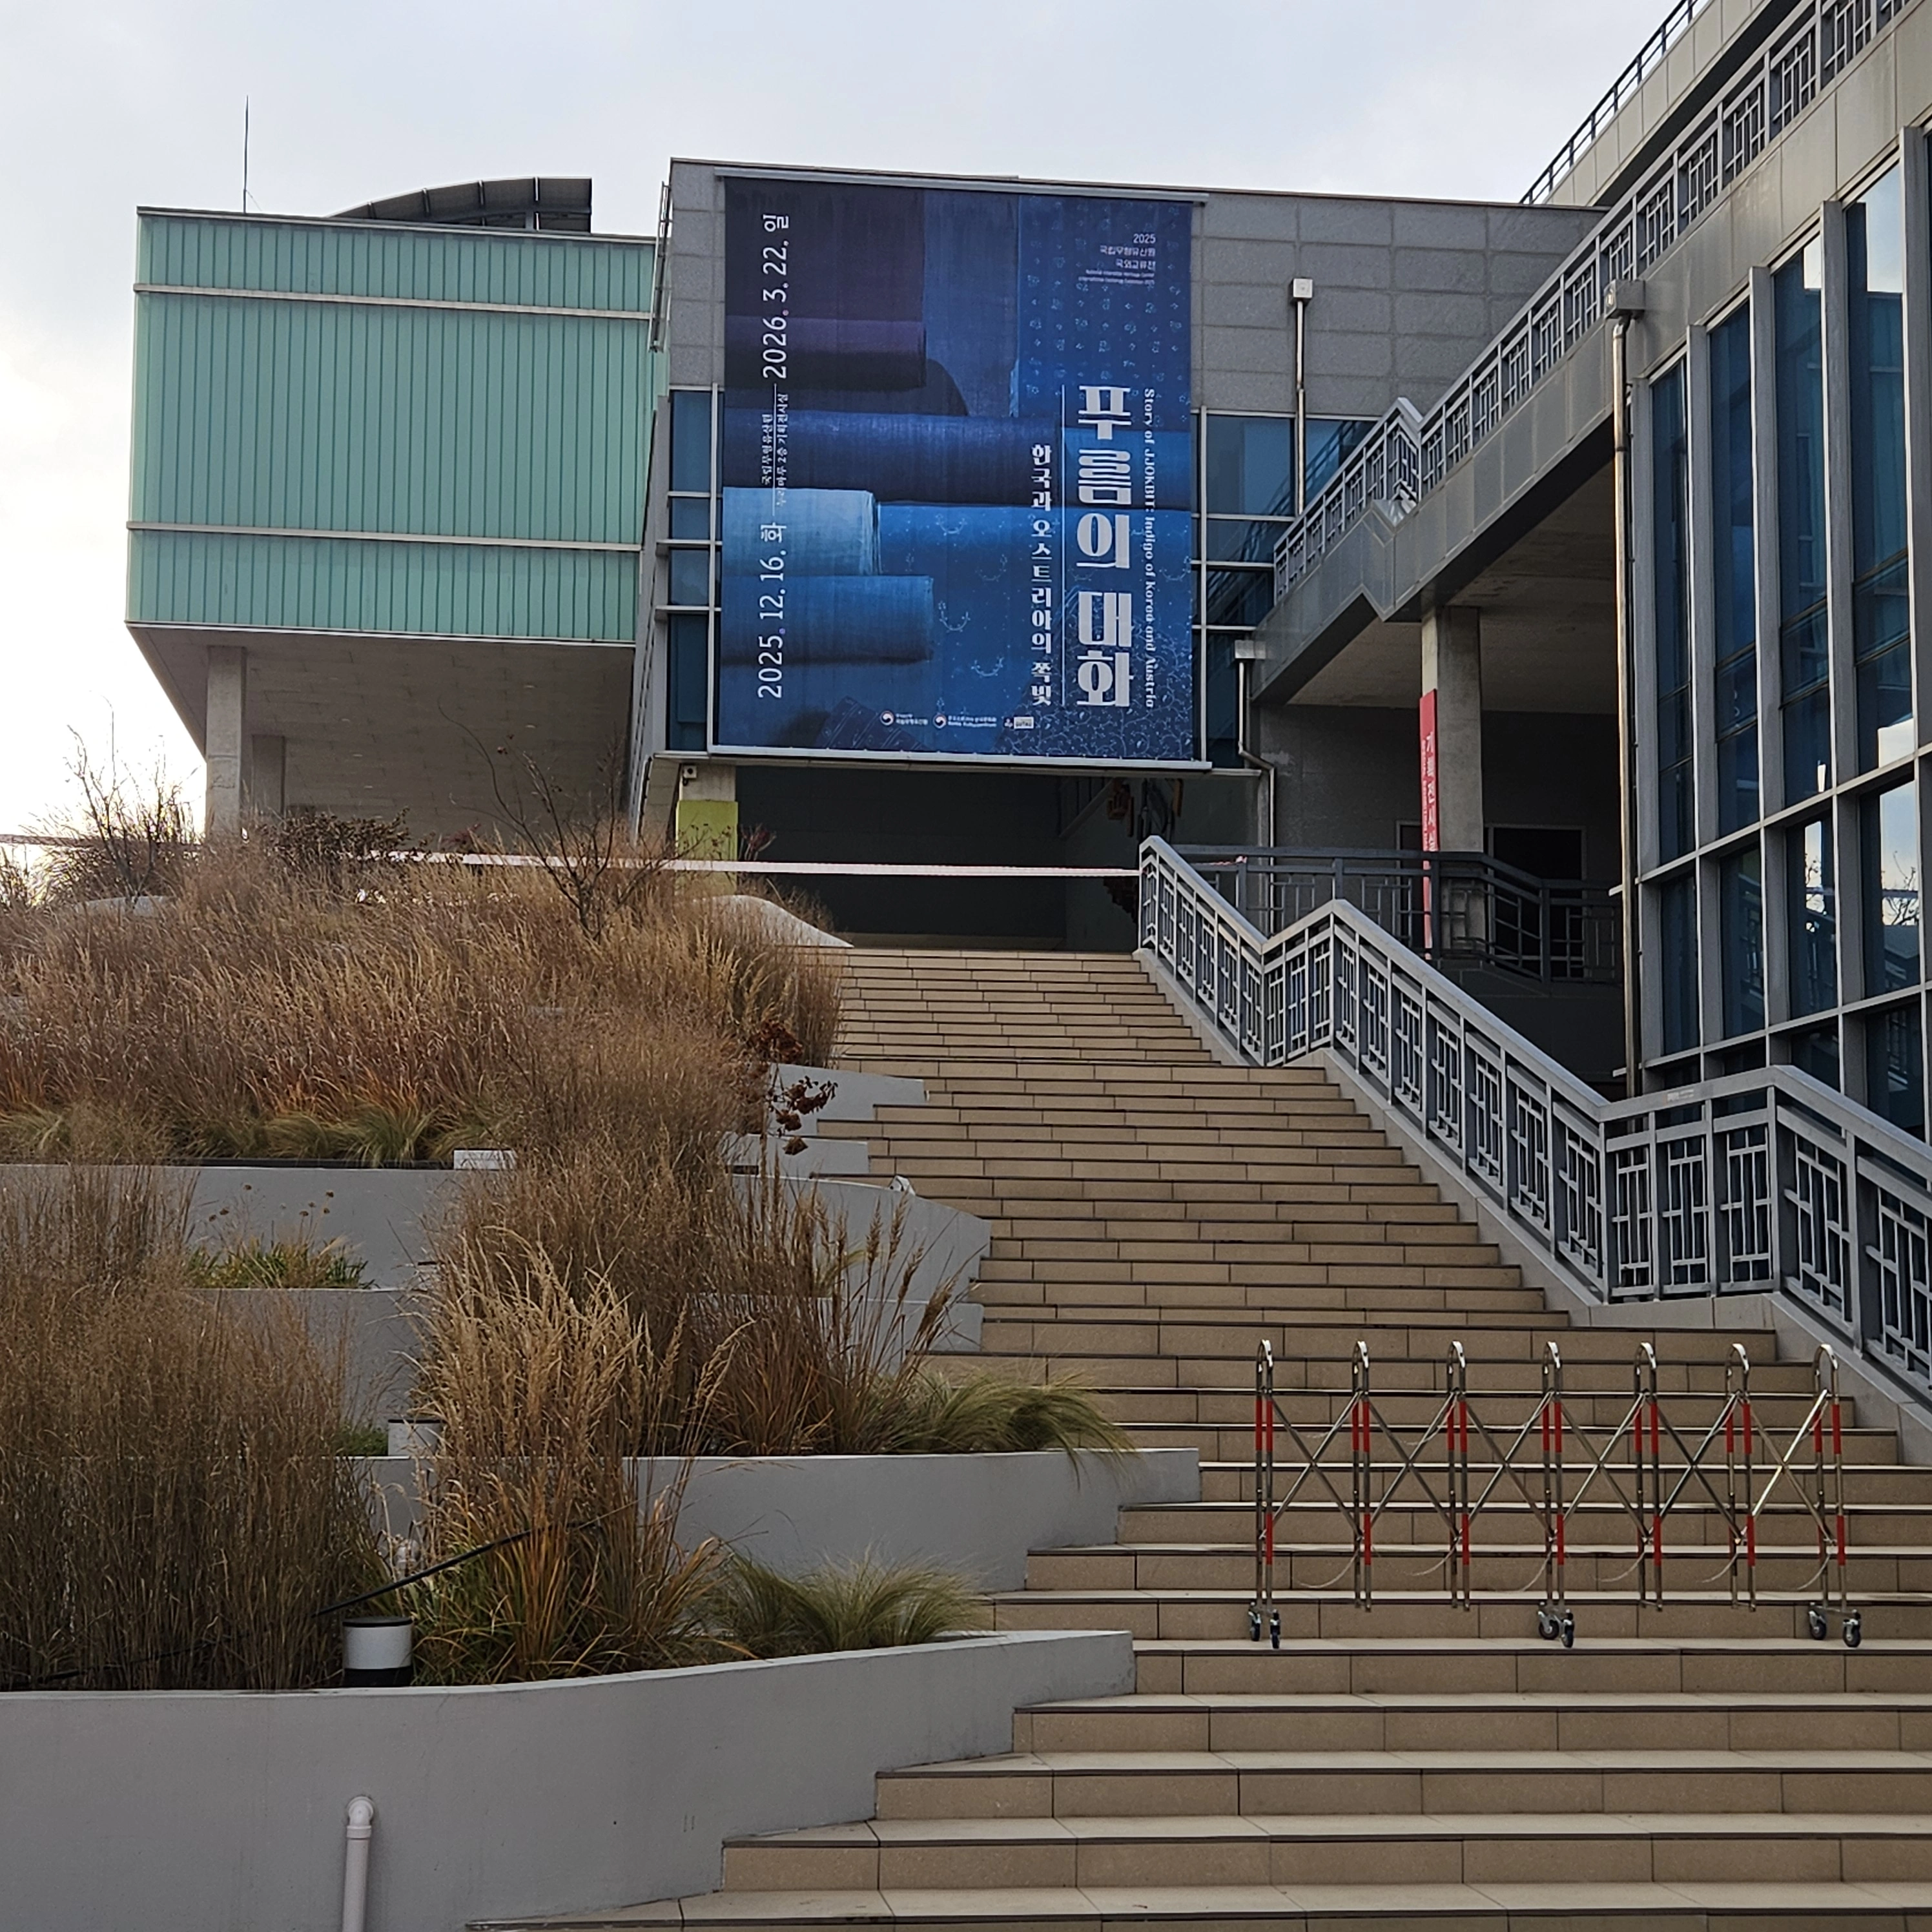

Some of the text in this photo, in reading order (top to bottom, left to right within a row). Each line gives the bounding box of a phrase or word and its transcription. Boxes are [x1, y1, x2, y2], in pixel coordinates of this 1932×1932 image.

[763, 214, 789, 379] 2026. 3. 22. 일
[1133, 233, 1156, 243] 2025
[762, 414, 773, 485] 국립무형유산원
[777, 394, 788, 445] 기획전시실
[777, 447, 787, 463] 2층
[757, 522, 787, 698] 2025. 12. 16. 화
[1031, 444, 1052, 706] 한국과 오스트리아의 쪽빛
[1076, 385, 1134, 707] 푸름의 대화
[1142, 388, 1156, 708] Story of JJOKBIT: Indigo of Korea and Austria
